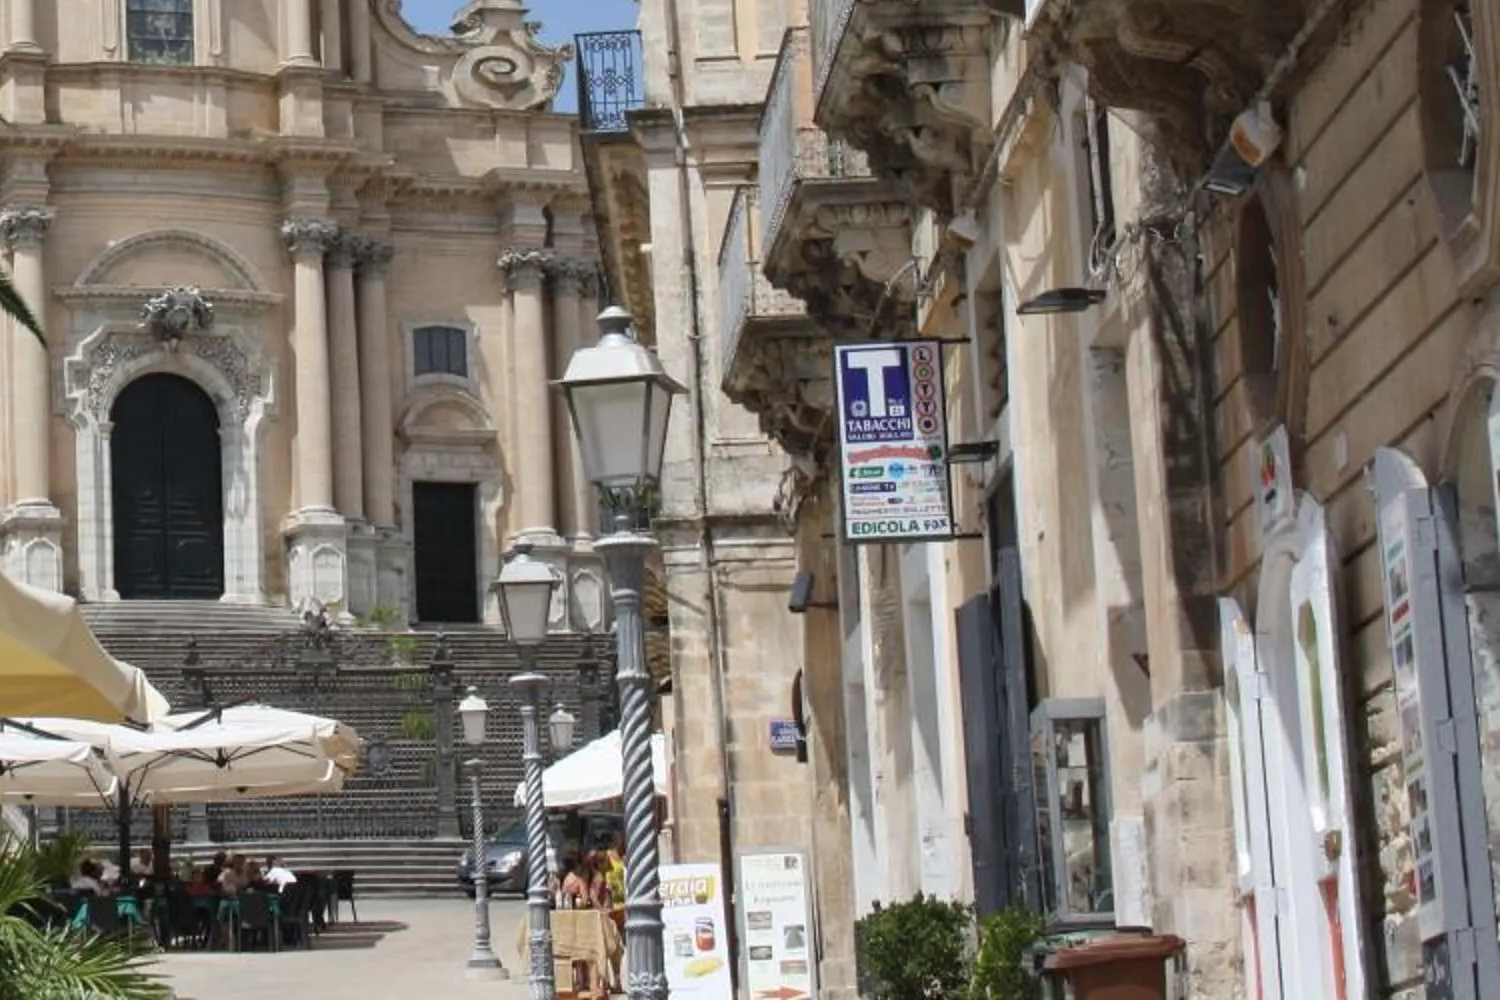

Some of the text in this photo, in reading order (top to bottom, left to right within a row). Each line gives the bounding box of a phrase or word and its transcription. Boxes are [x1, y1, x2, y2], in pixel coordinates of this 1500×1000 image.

[847, 349, 901, 417] T
[847, 417, 911, 433] TABACCHI
[851, 519, 921, 535] EDICOLA
